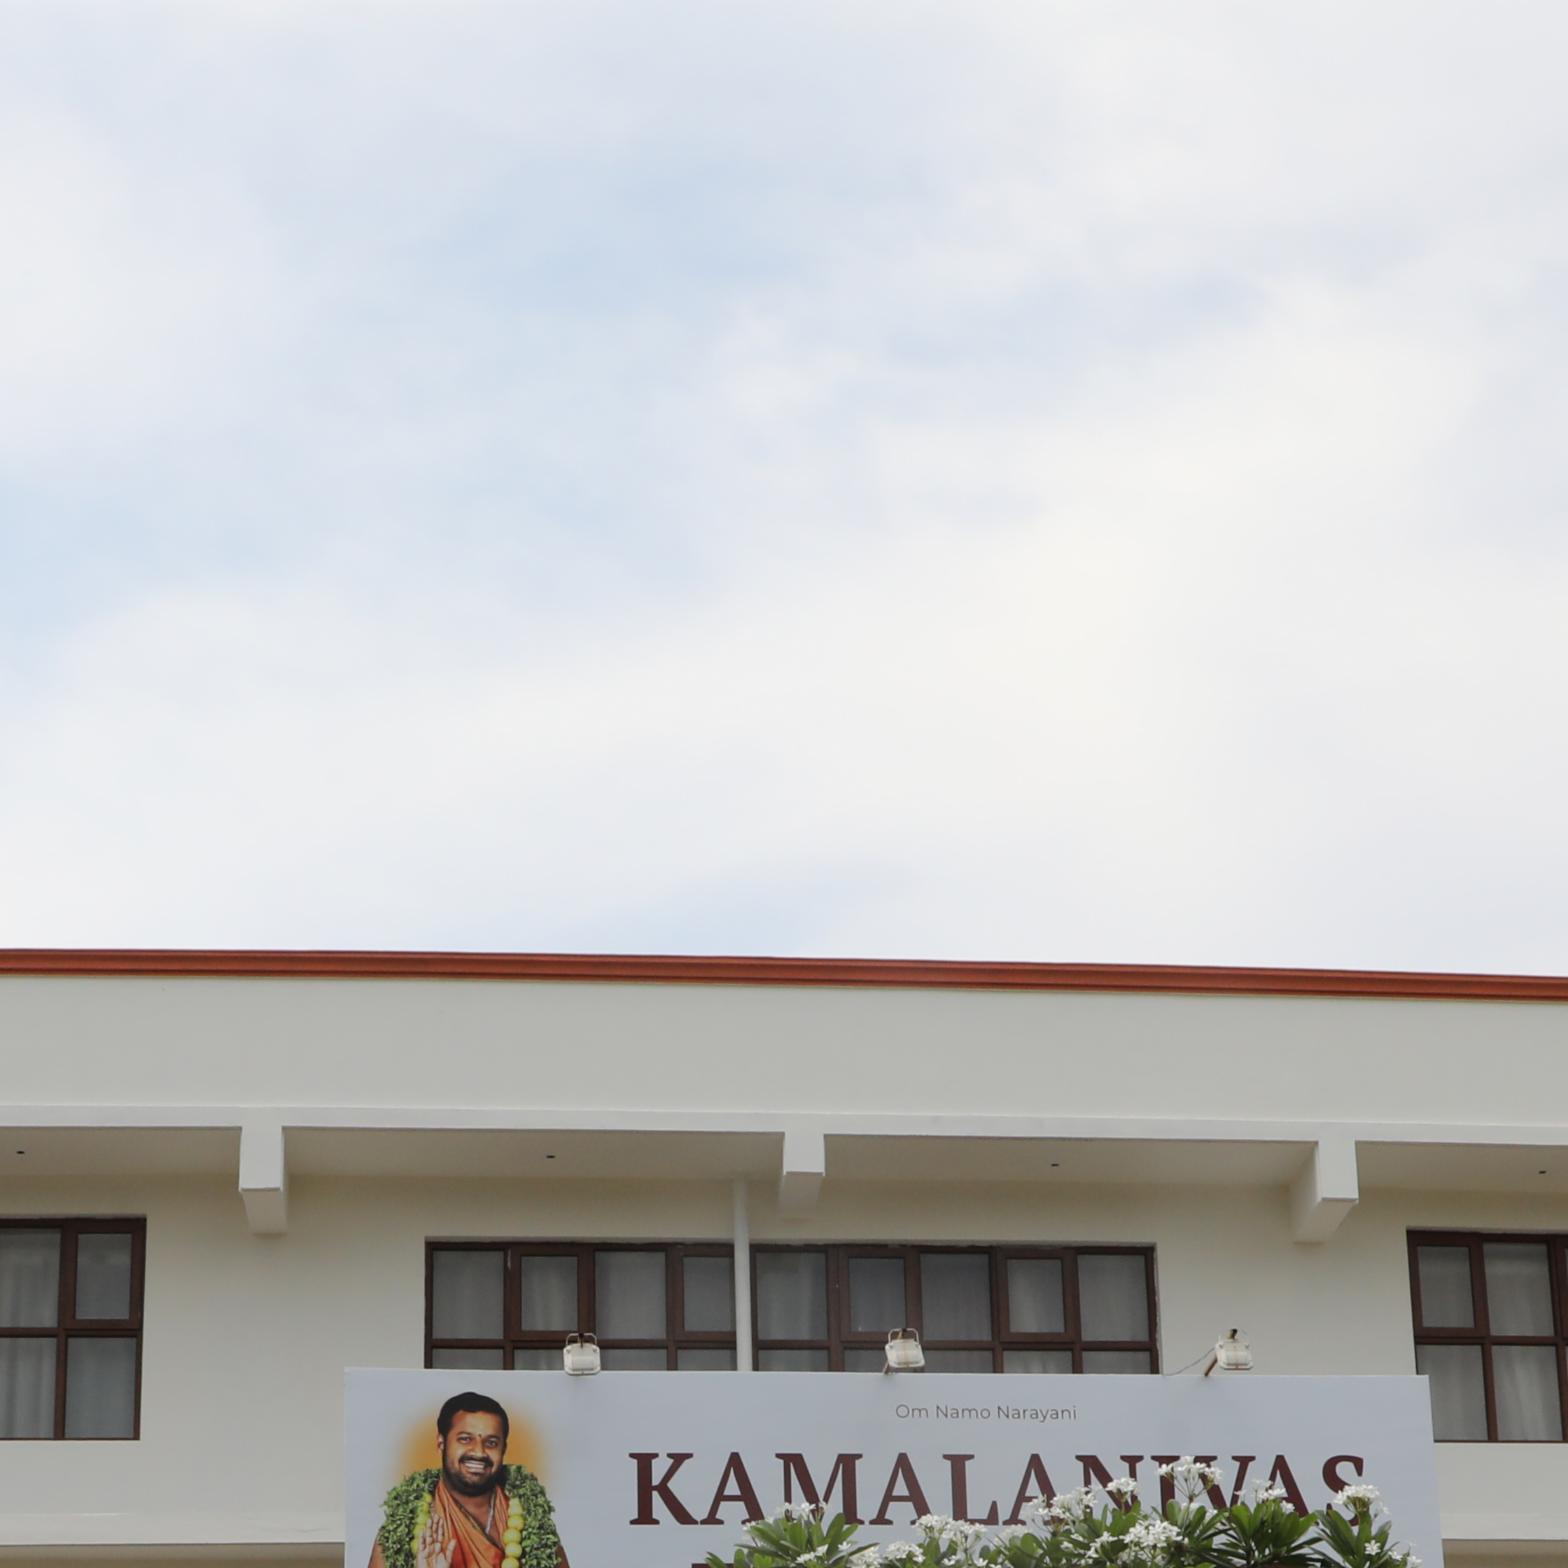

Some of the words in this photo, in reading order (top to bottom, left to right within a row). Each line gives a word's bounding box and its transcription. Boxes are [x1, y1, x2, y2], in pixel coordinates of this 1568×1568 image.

[895, 1404, 929, 1419] Om
[935, 1405, 991, 1420] Namo
[997, 1406, 1077, 1424] Narayani
[628, 1451, 1365, 1527] KAMALANIVAS
